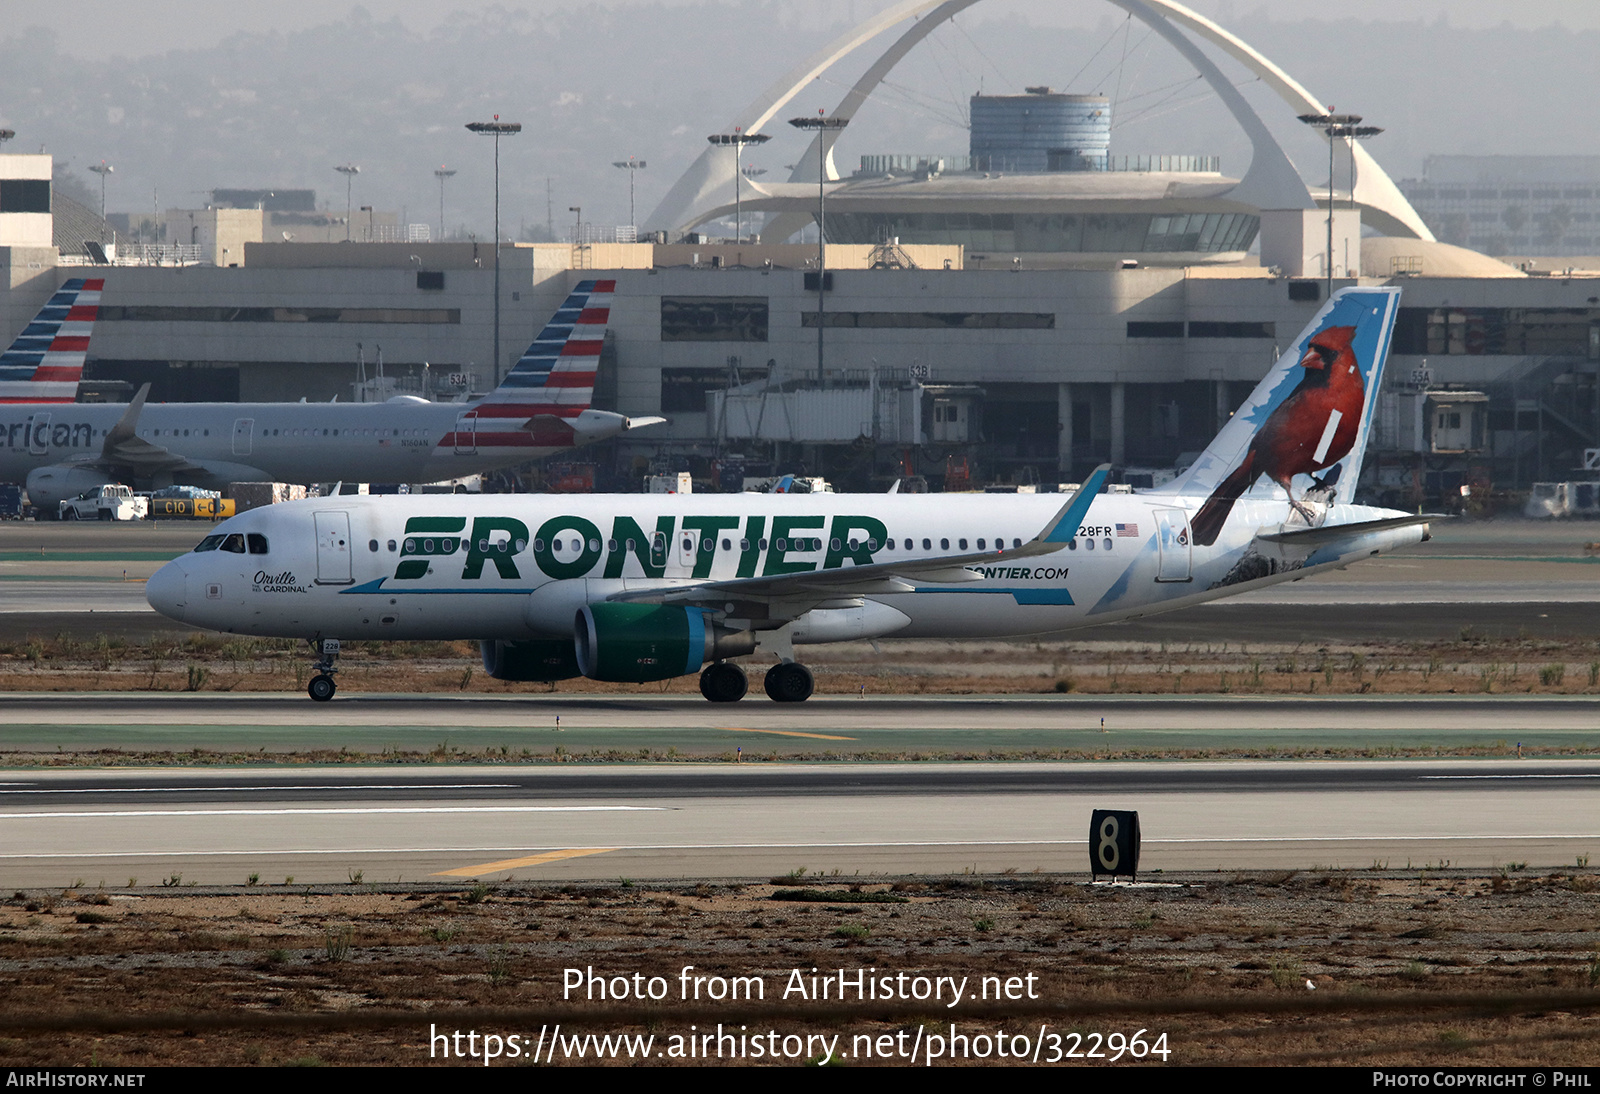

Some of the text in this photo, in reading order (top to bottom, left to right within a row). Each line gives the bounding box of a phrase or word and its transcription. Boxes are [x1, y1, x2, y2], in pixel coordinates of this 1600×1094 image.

[910, 365, 928, 377] 53B
[1412, 370, 1430, 382] 55A
[449, 374, 467, 385] 53A
[165, 501, 186, 514] C10
[1075, 526, 1112, 537] 28FR
[394, 515, 888, 580] FRONTIER
[253, 570, 296, 585] Orville
[263, 585, 308, 594] CARDINAL
[325, 642, 339, 650] 228
[1098, 815, 1120, 871] 8
